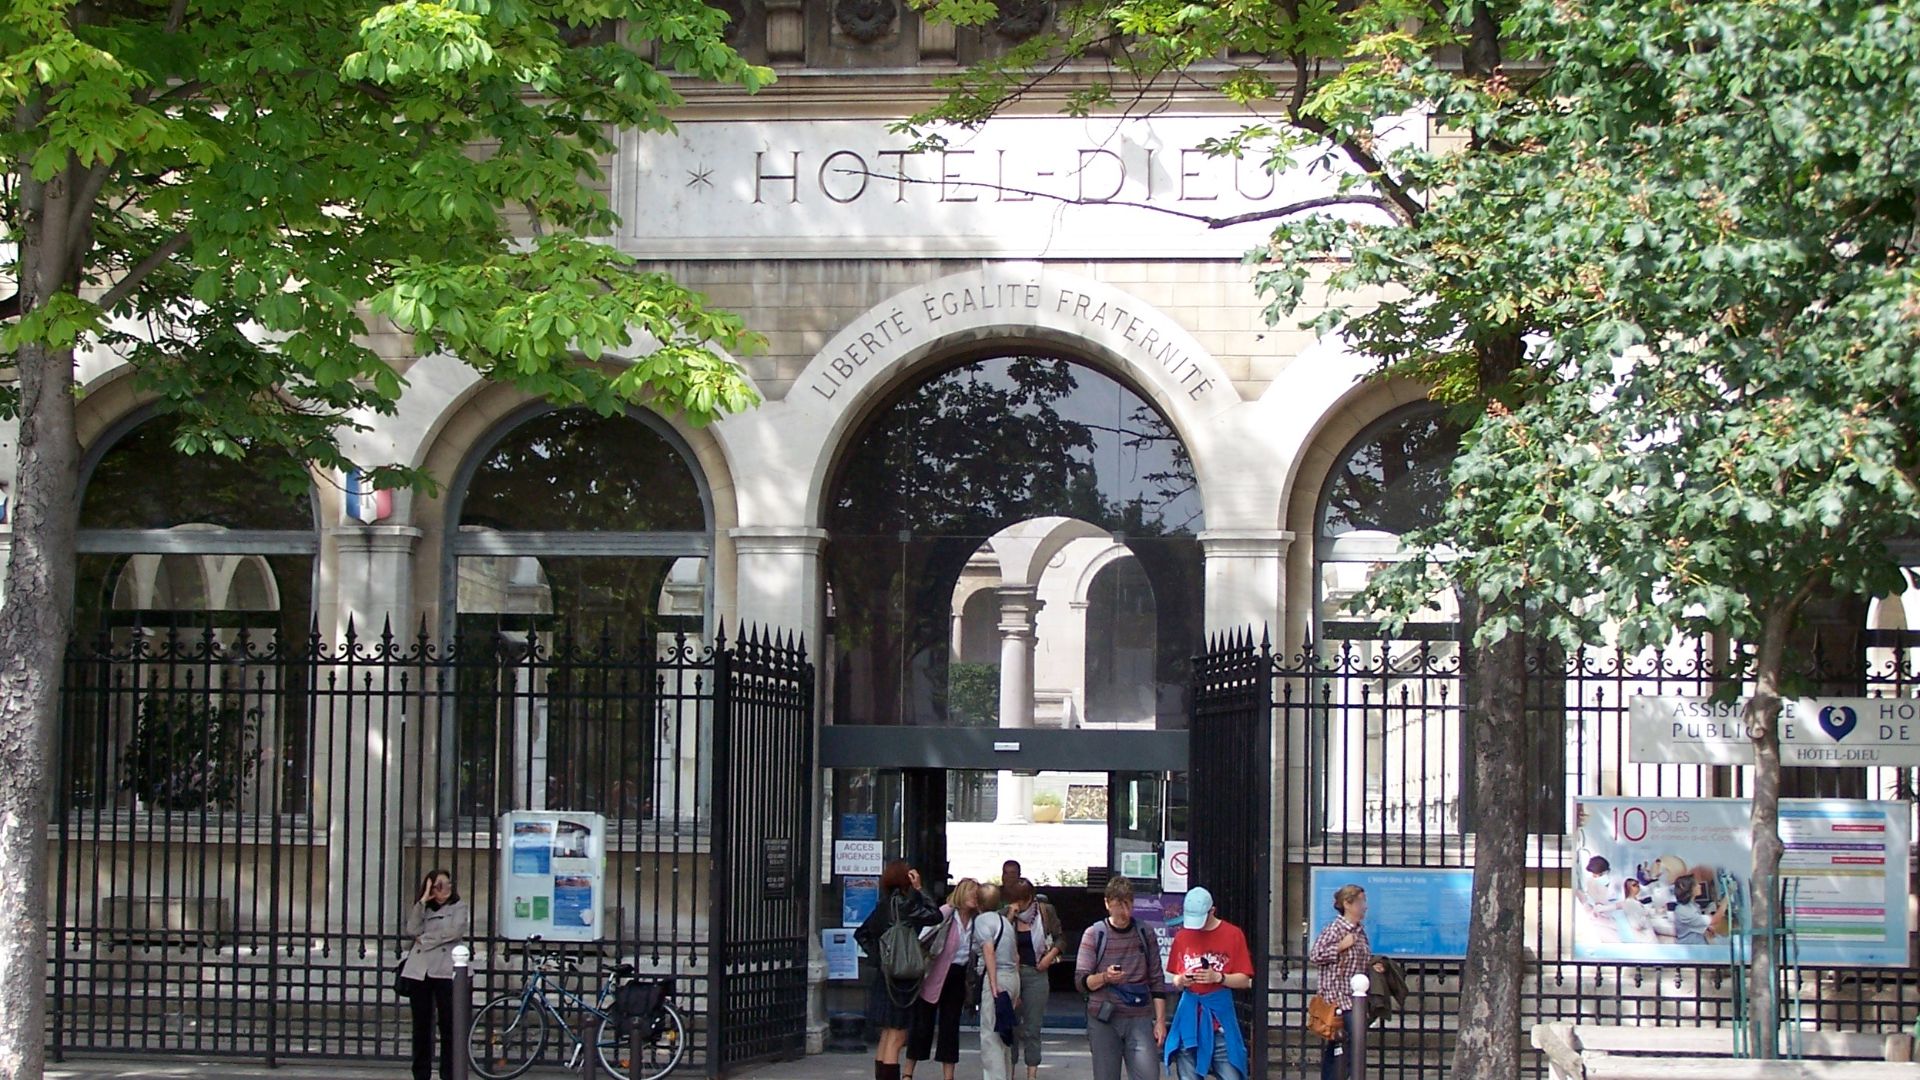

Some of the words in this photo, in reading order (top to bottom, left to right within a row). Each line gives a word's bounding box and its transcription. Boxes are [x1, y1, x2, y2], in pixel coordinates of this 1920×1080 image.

[753, 148, 1275, 203] HOTEL-DIEU
[811, 307, 912, 401] LIBERTÉ
[922, 279, 1041, 323] ÉGALITÉ
[1056, 289, 1219, 402] FRATERNITÉ
[1672, 702, 1796, 719] ASSISTE
[1879, 725, 1910, 740] DE
[1797, 748, 1880, 761] HÔTEL-DIEU
[1650, 808, 1690, 823] PÔLES
[1613, 807, 1648, 841] 10
[837, 852, 882, 861] URGENCES
